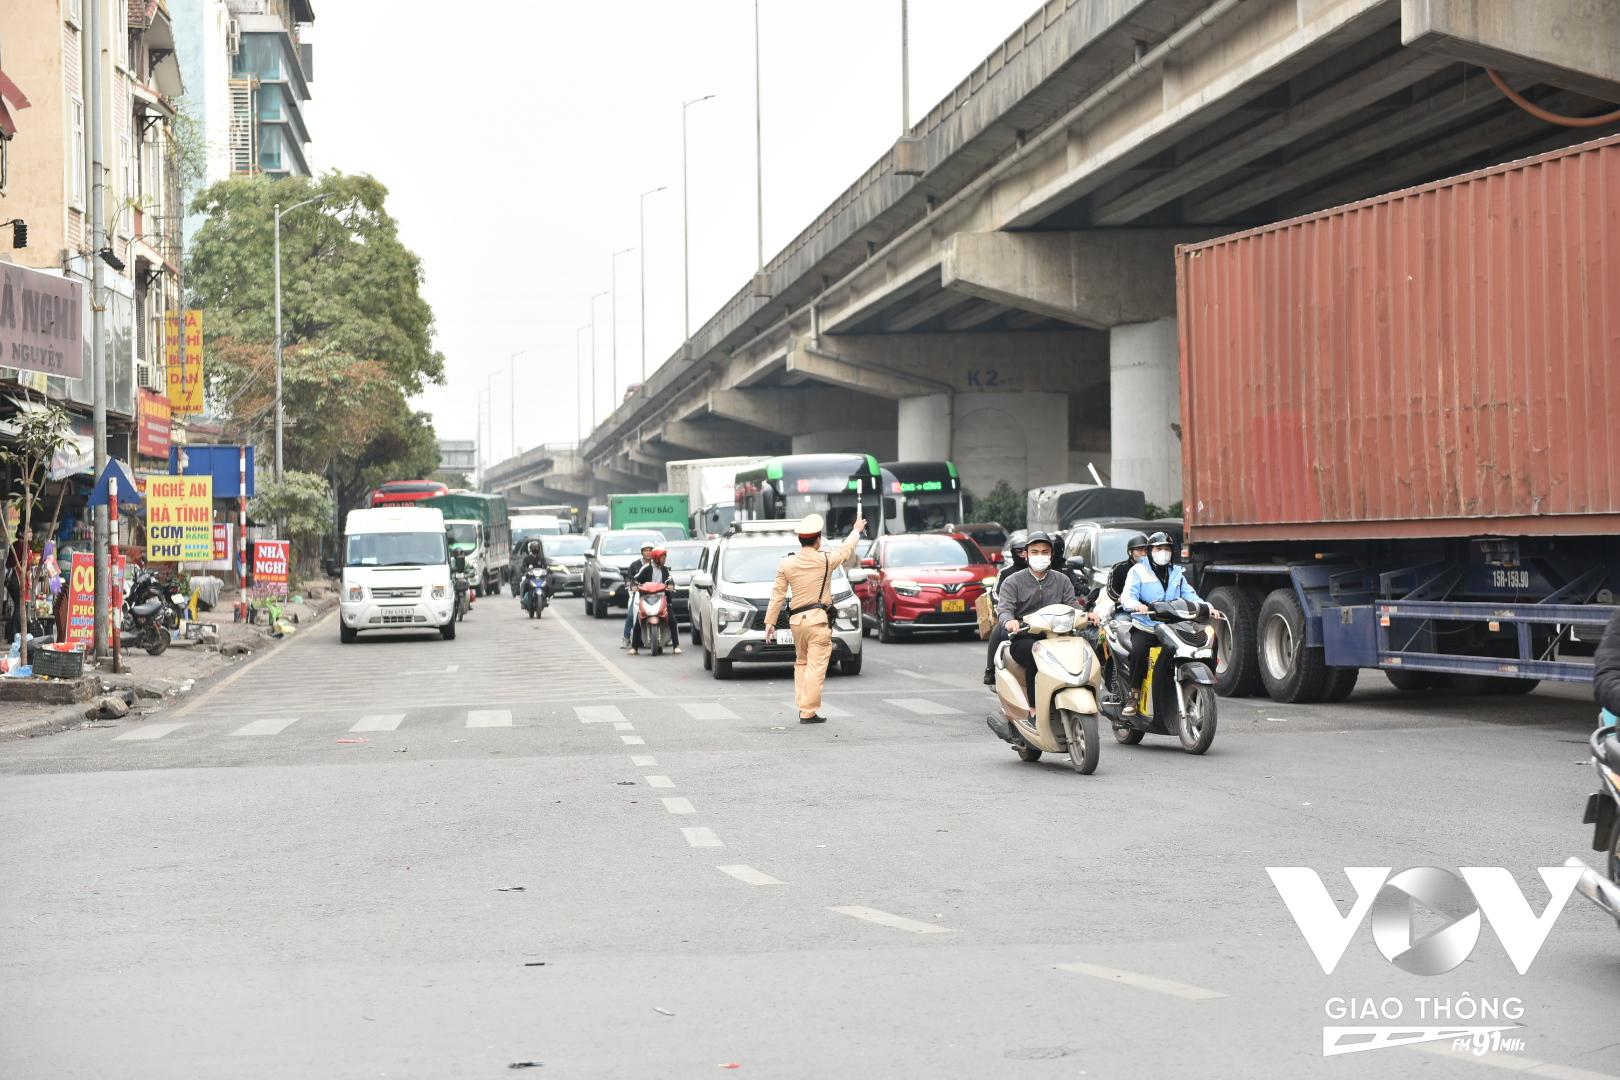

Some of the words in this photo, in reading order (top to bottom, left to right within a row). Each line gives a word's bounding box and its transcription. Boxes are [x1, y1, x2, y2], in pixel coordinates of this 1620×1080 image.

[22, 282, 77, 341] NGHỈ
[168, 312, 197, 327] NÀ
[167, 330, 201, 346] NHỈ
[12, 342, 63, 373] NGUYỆT
[169, 351, 201, 366] BÌH
[152, 479, 186, 501] NGHỆ
[189, 483, 207, 497] AN
[150, 503, 171, 522] HÀ
[175, 503, 209, 523] TĨNH
[629, 506, 638, 514] XE
[657, 504, 674, 514] BÁO
[151, 525, 183, 539] CƠM
[152, 539, 182, 557] PHỞ
[258, 543, 285, 559] NHÀ
[1492, 570, 1529, 588] 15R-159.90
[70, 626, 94, 638] MIẾN
